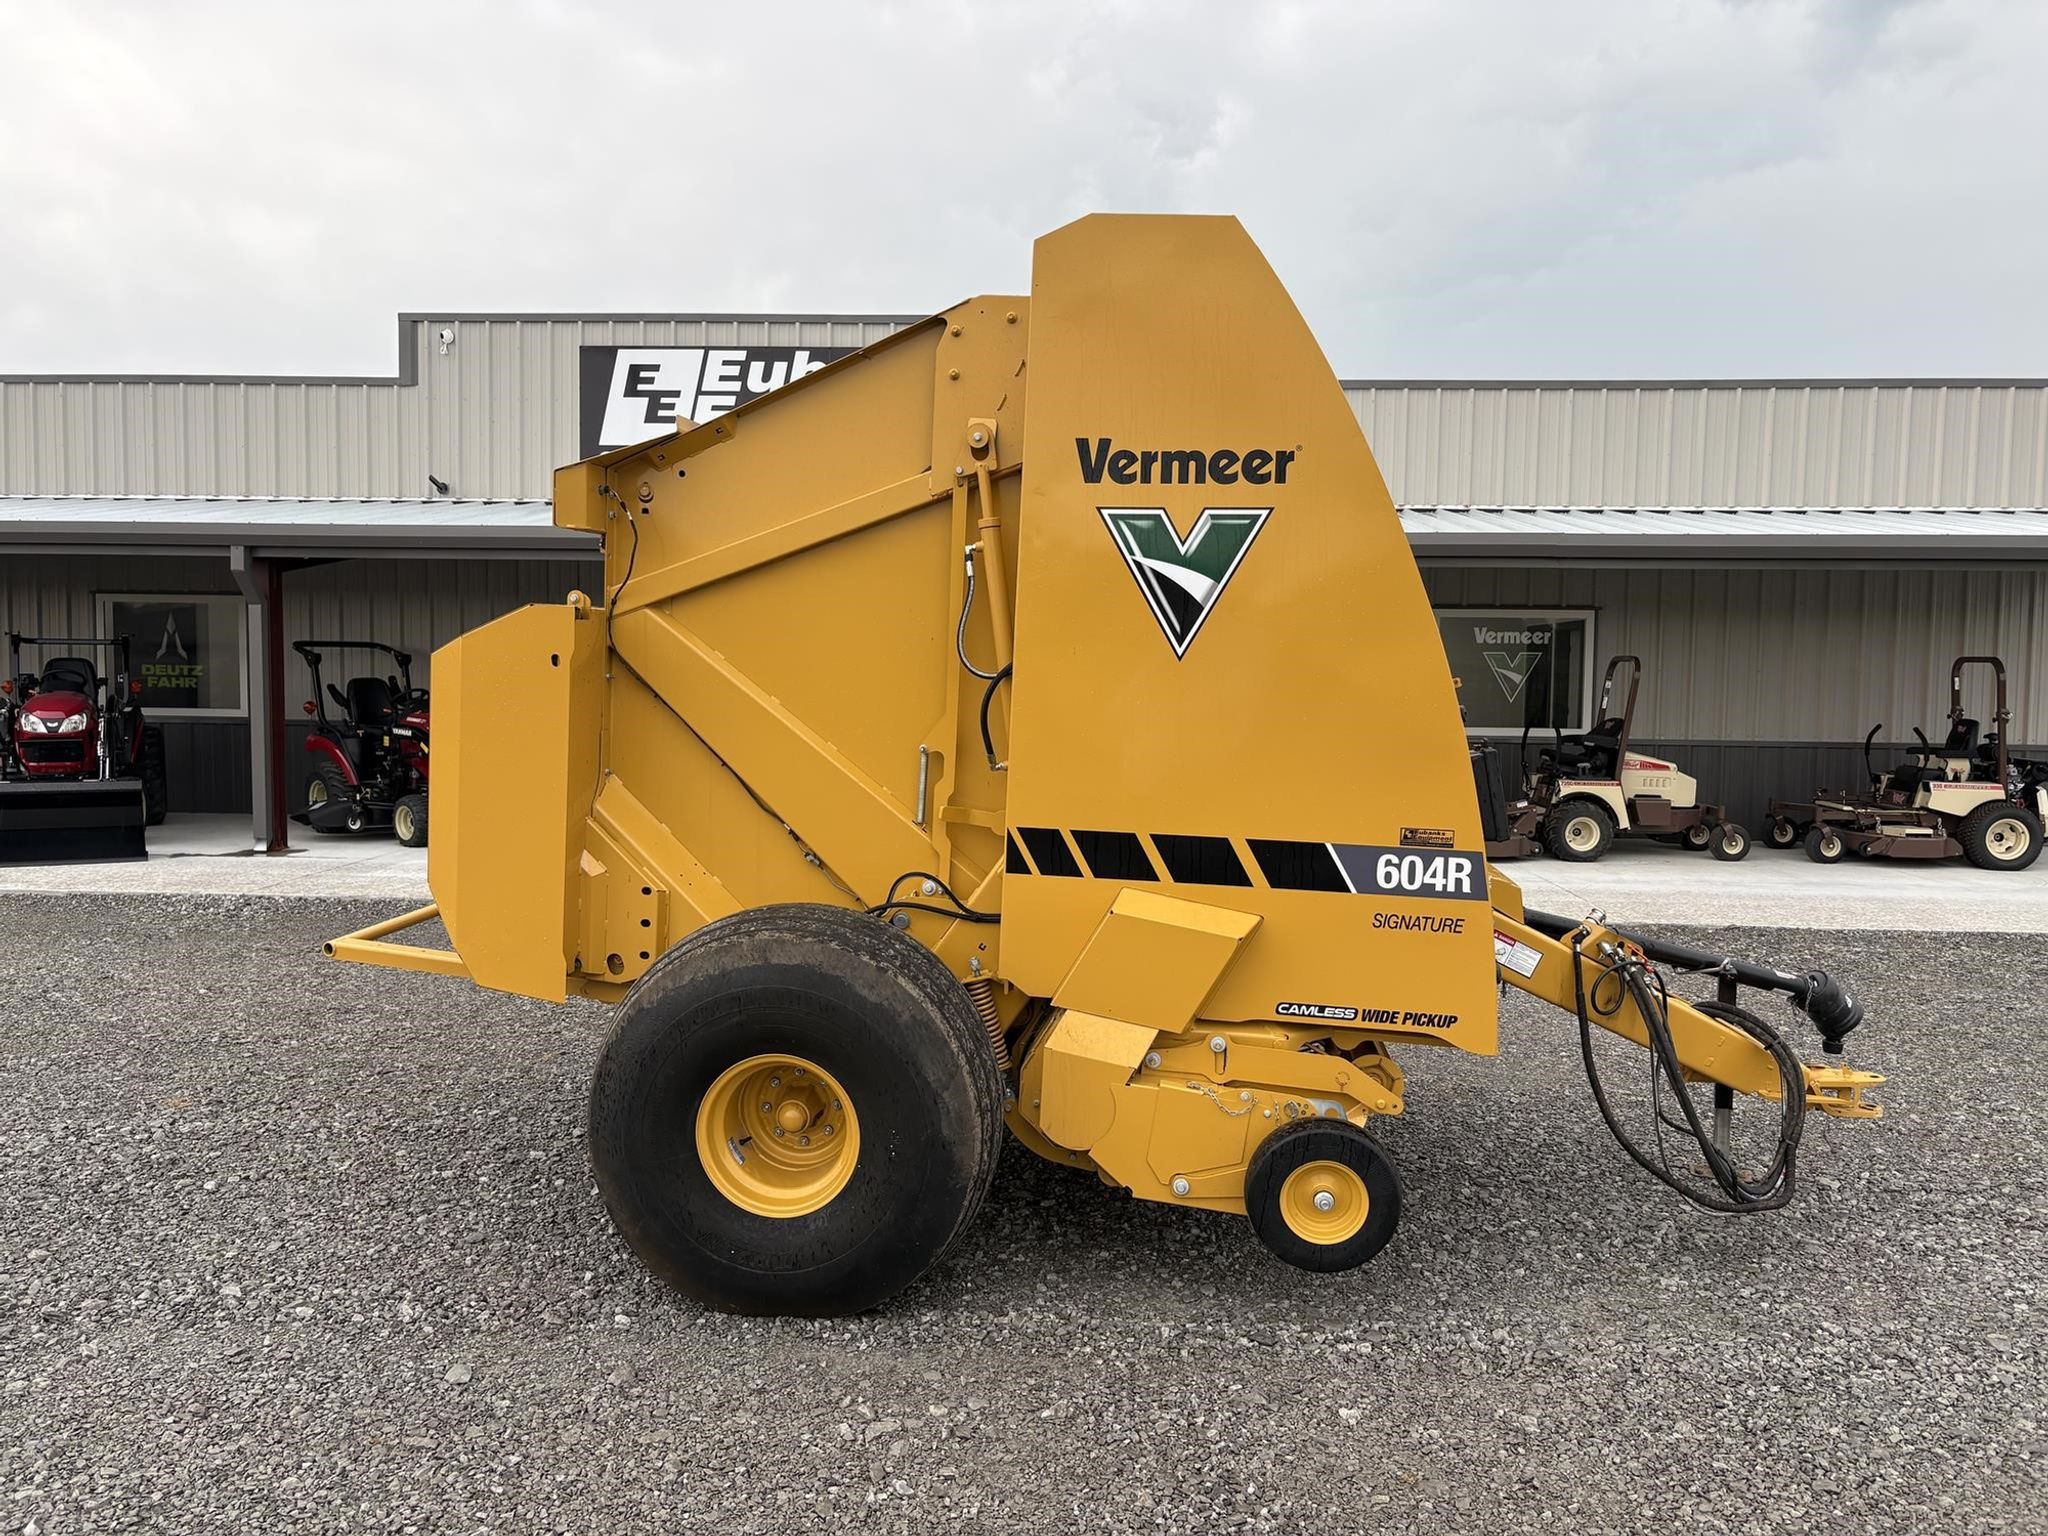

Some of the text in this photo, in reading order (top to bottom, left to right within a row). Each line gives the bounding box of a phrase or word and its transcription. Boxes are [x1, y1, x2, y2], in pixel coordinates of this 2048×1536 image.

[1075, 438, 1295, 485] Vermeer
[1473, 626, 1552, 645] Vermeer
[141, 663, 204, 676] DEUTZ
[147, 676, 198, 688] FAHR
[1376, 854, 1473, 894] 604R
[1372, 912, 1466, 934] SIGNATURE
[1277, 1003, 1459, 1029] CAMLESS WIDE PICKUP
